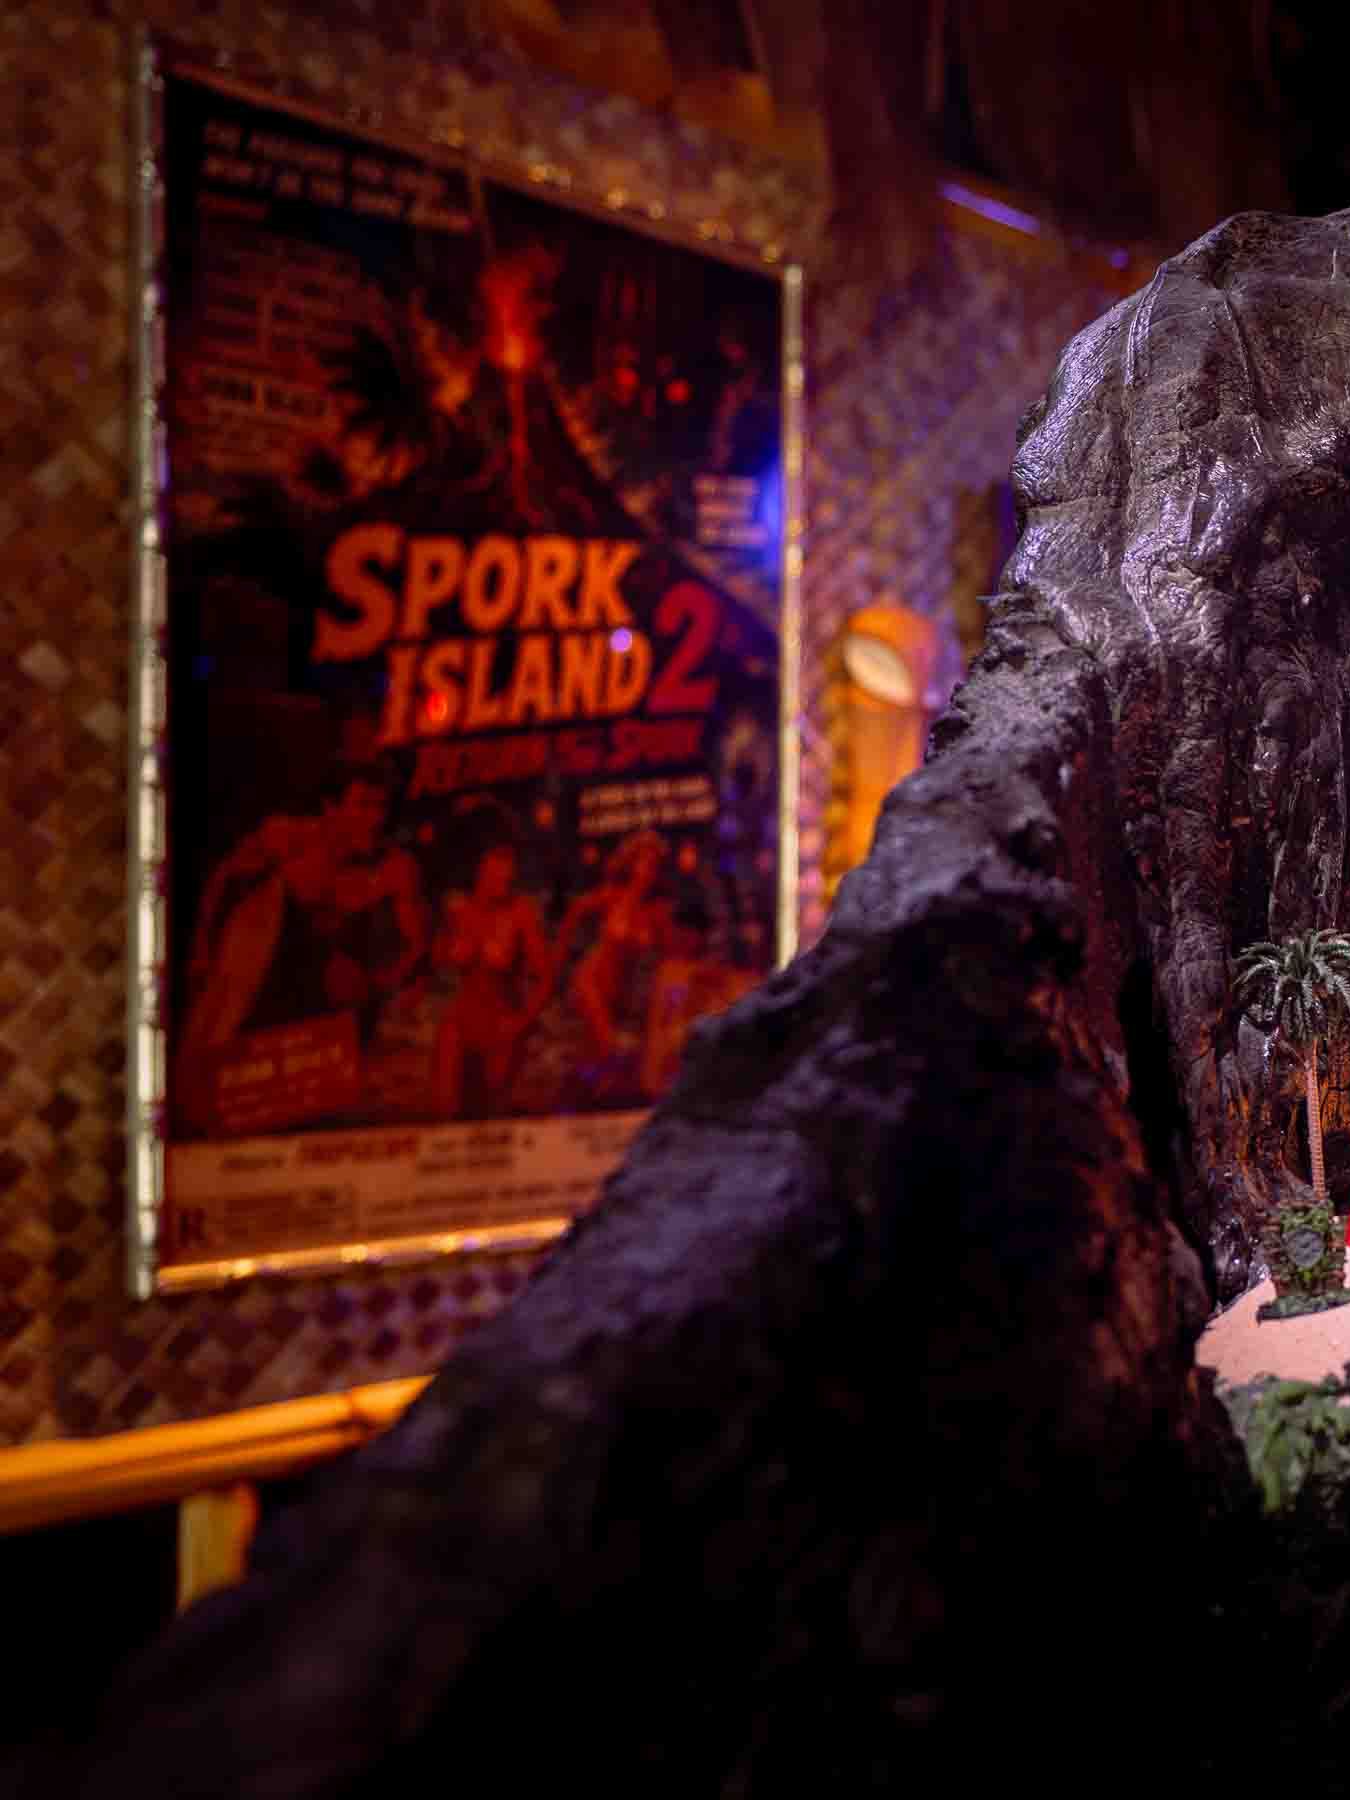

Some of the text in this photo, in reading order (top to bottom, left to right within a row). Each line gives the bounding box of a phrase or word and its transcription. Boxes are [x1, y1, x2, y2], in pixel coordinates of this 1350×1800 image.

[313, 522, 642, 661] SPORK
[377, 581, 721, 747] ISLAND 2
